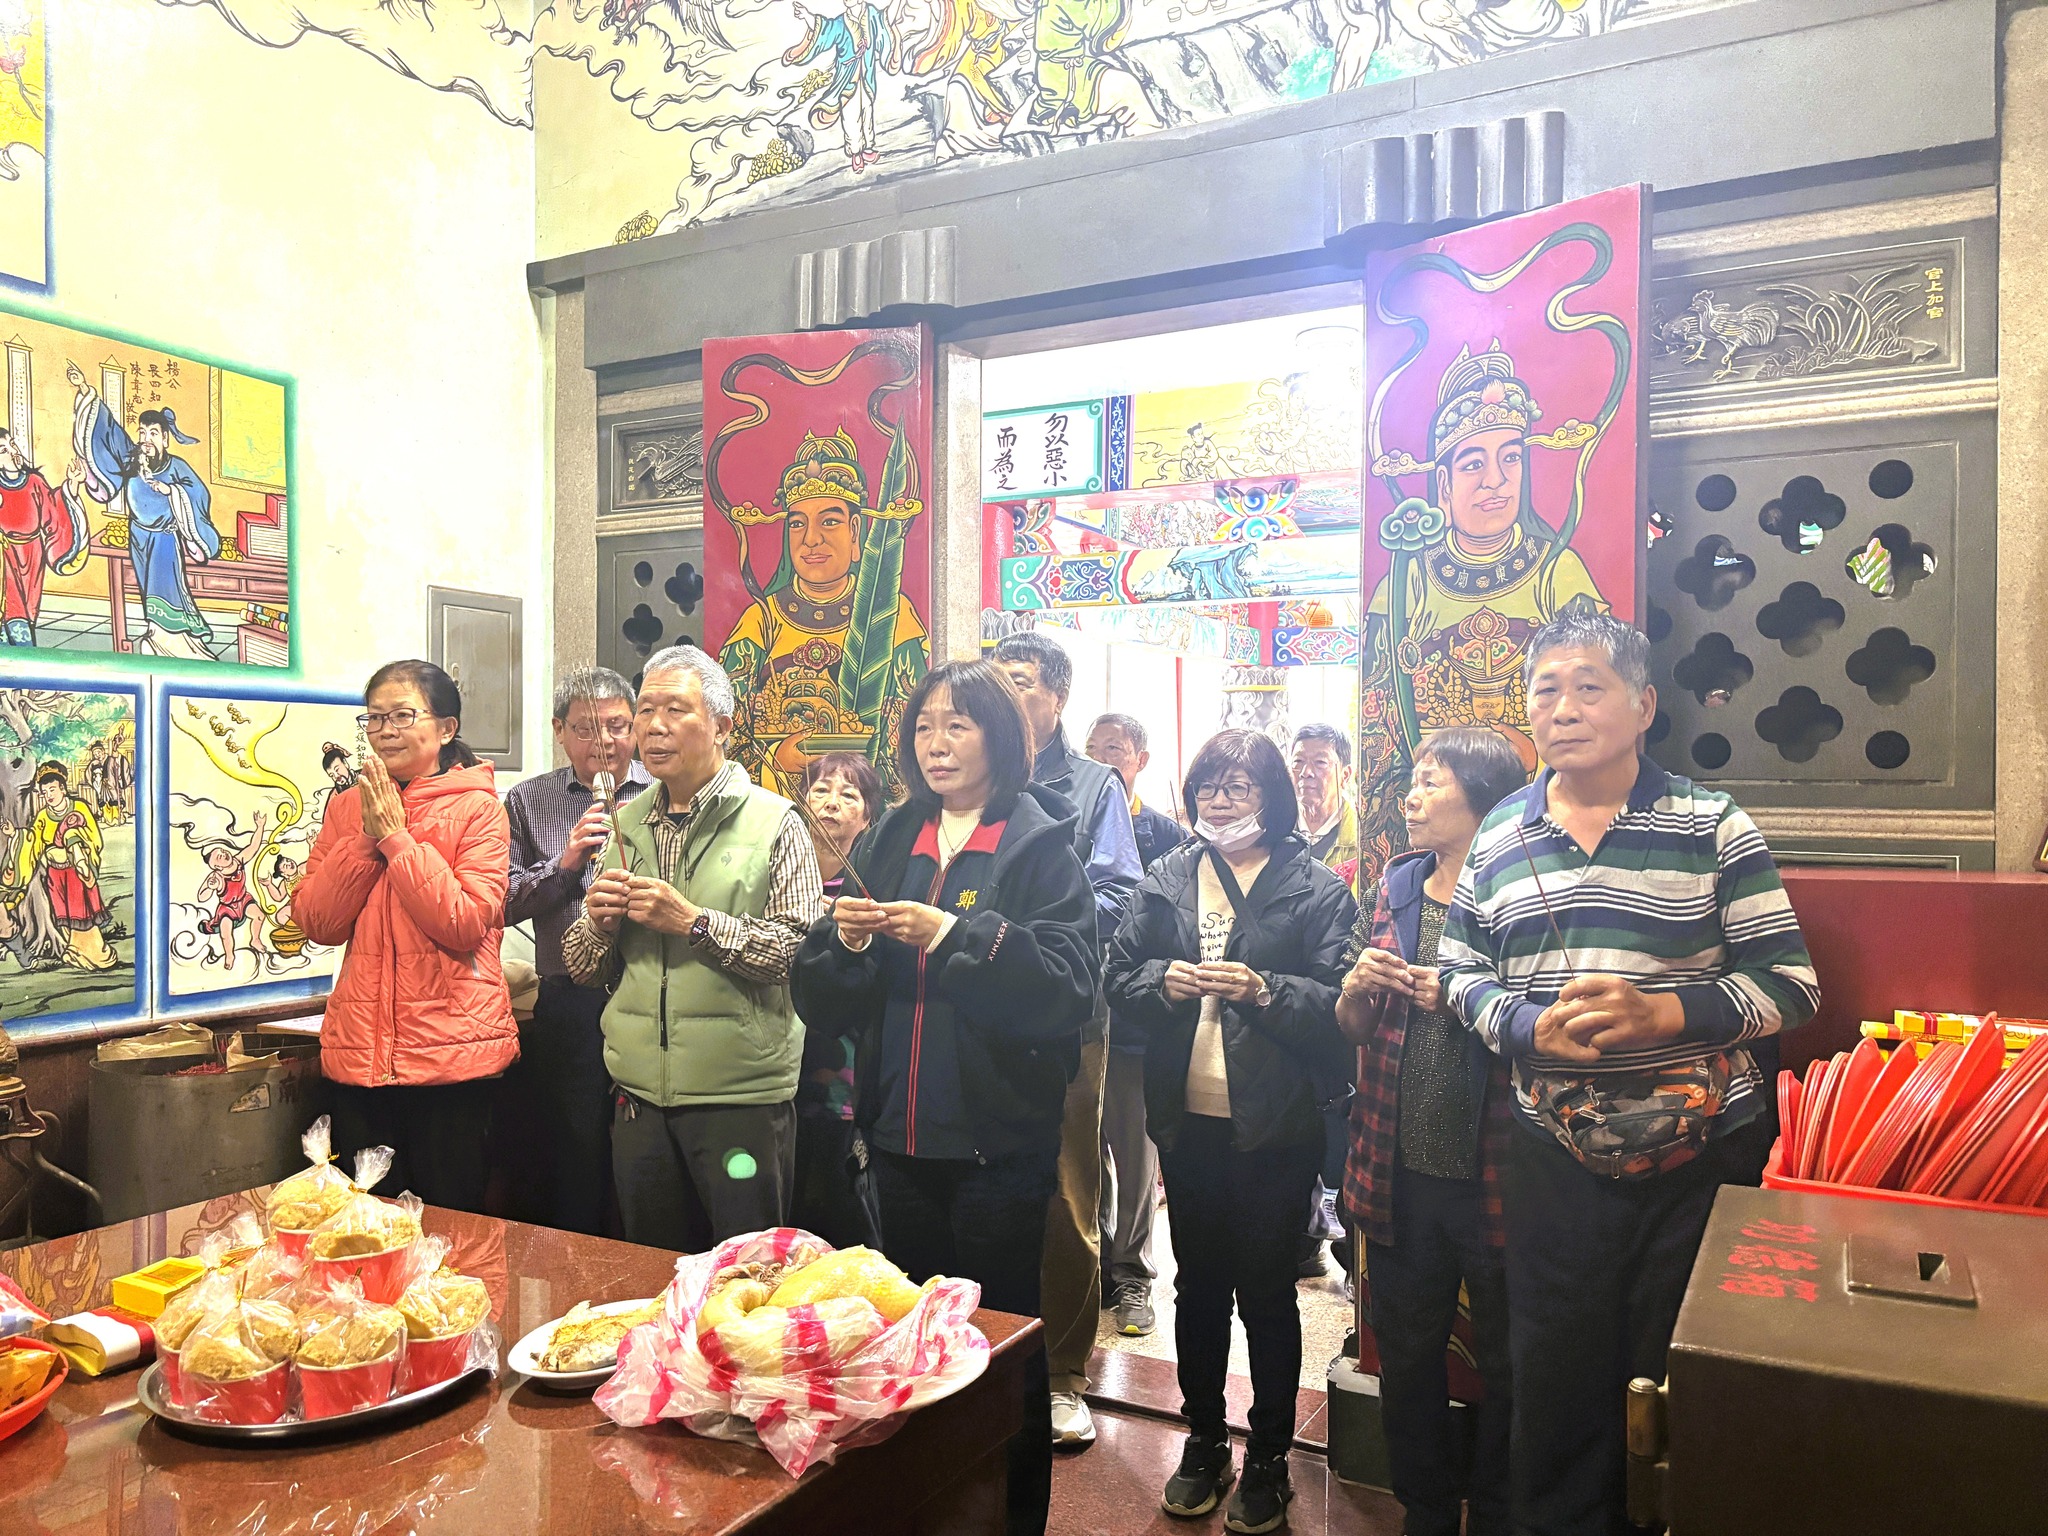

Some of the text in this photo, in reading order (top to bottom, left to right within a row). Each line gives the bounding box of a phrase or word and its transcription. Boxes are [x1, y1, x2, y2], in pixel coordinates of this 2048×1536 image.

[988, 426, 1018, 490] 而為之
[1044, 412, 1069, 487] 勿以惡小
[955, 888, 978, 911] 鄭
